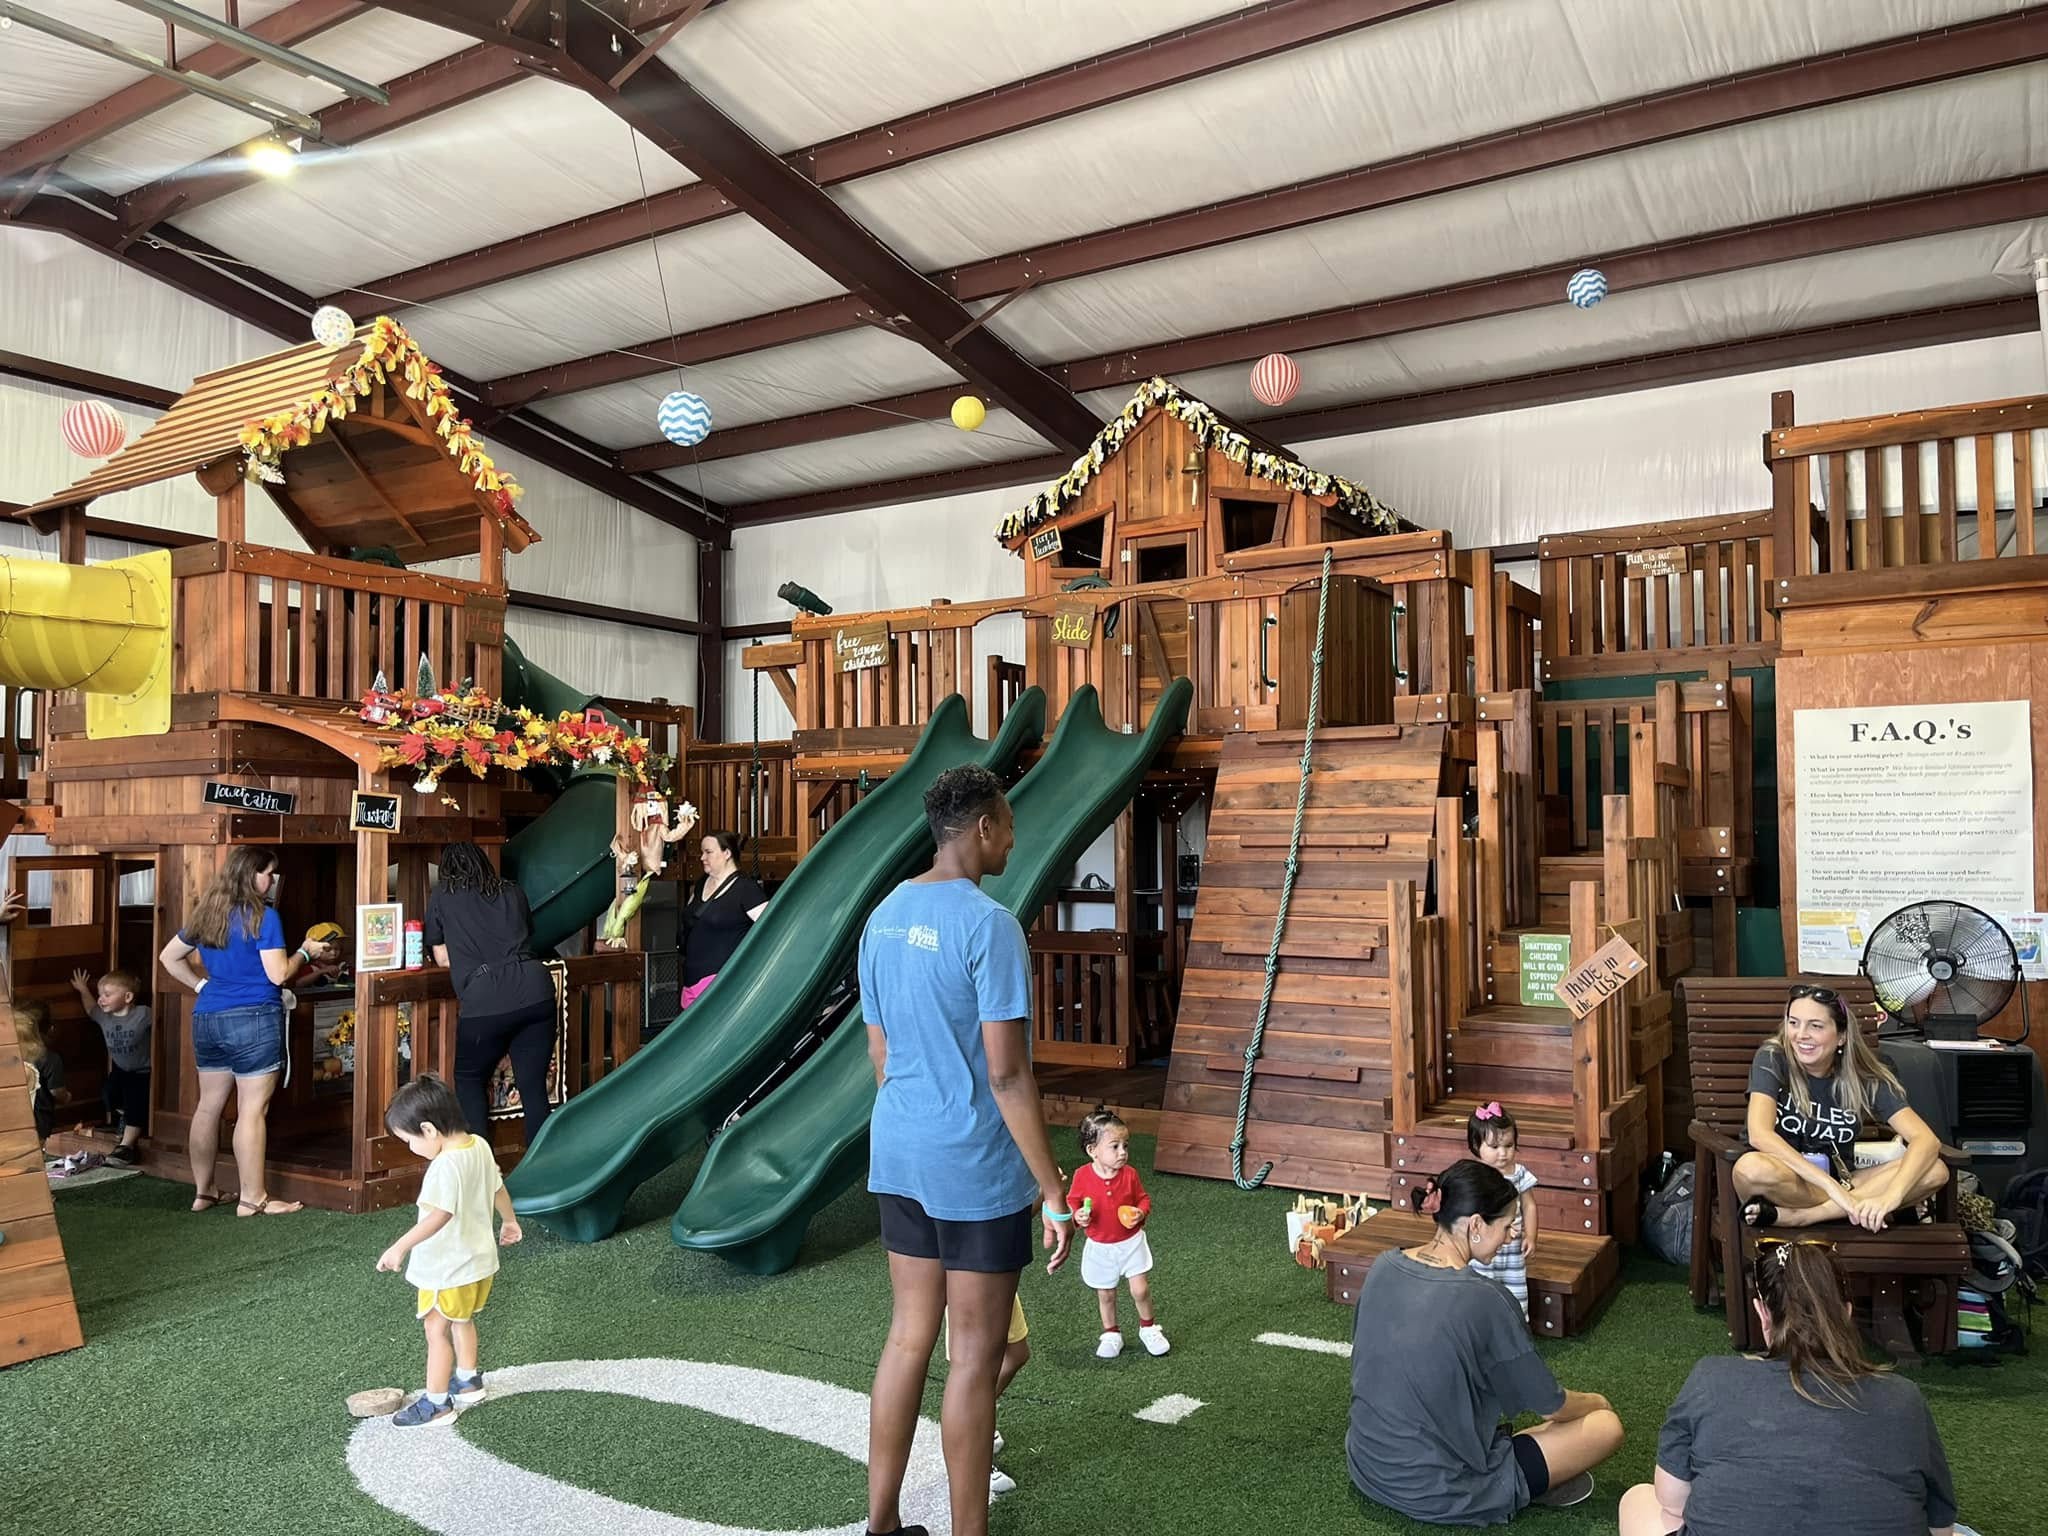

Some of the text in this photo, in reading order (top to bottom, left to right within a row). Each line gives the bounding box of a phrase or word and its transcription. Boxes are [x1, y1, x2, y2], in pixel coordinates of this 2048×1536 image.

[1642, 560, 1667, 570] middle
[1052, 614, 1092, 641] Slide
[837, 629, 861, 654] free
[853, 641, 884, 658] range
[843, 655, 886, 672] children
[1849, 718, 1972, 745] F.A.Q.'s
[356, 801, 396, 829] Mustang
[1524, 942, 1563, 951] UNATTENDED
[1529, 952, 1558, 961] CHILDREN
[1603, 956, 1618, 970] in
[1523, 961, 1565, 972] WILL BE GIVEN
[1530, 971, 1558, 981] ESPRESSO
[1527, 981, 1540, 990] AND
[1541, 983, 1546, 991] A
[1576, 971, 1627, 1014] the USA
[1533, 992, 1555, 1001] KITTEN
